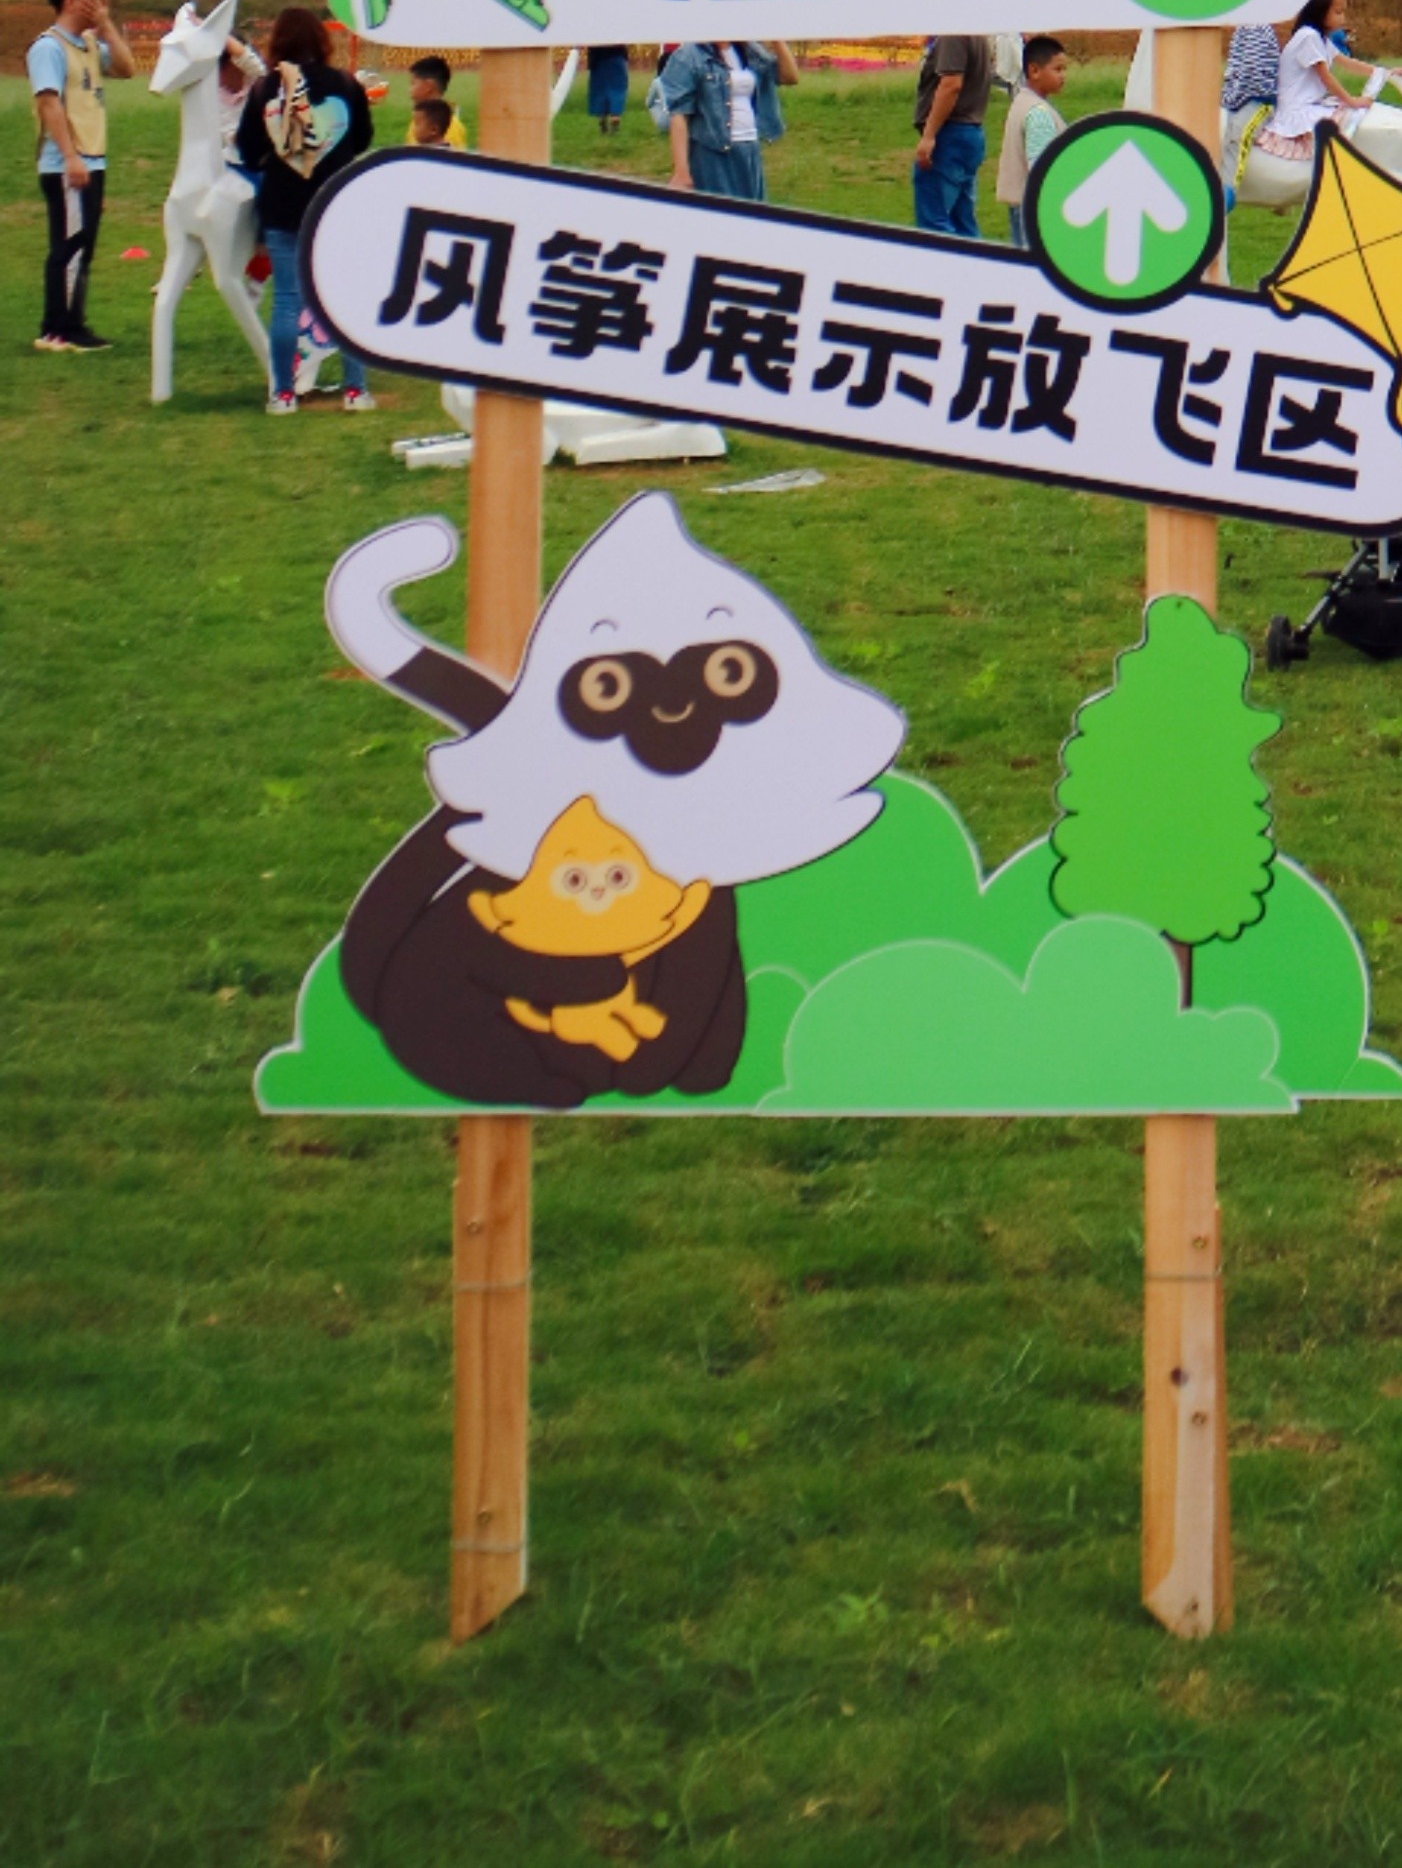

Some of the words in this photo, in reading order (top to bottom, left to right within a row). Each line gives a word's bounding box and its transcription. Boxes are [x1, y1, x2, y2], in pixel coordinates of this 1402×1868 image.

[379, 206, 1375, 491] 风筝展示放飞区
